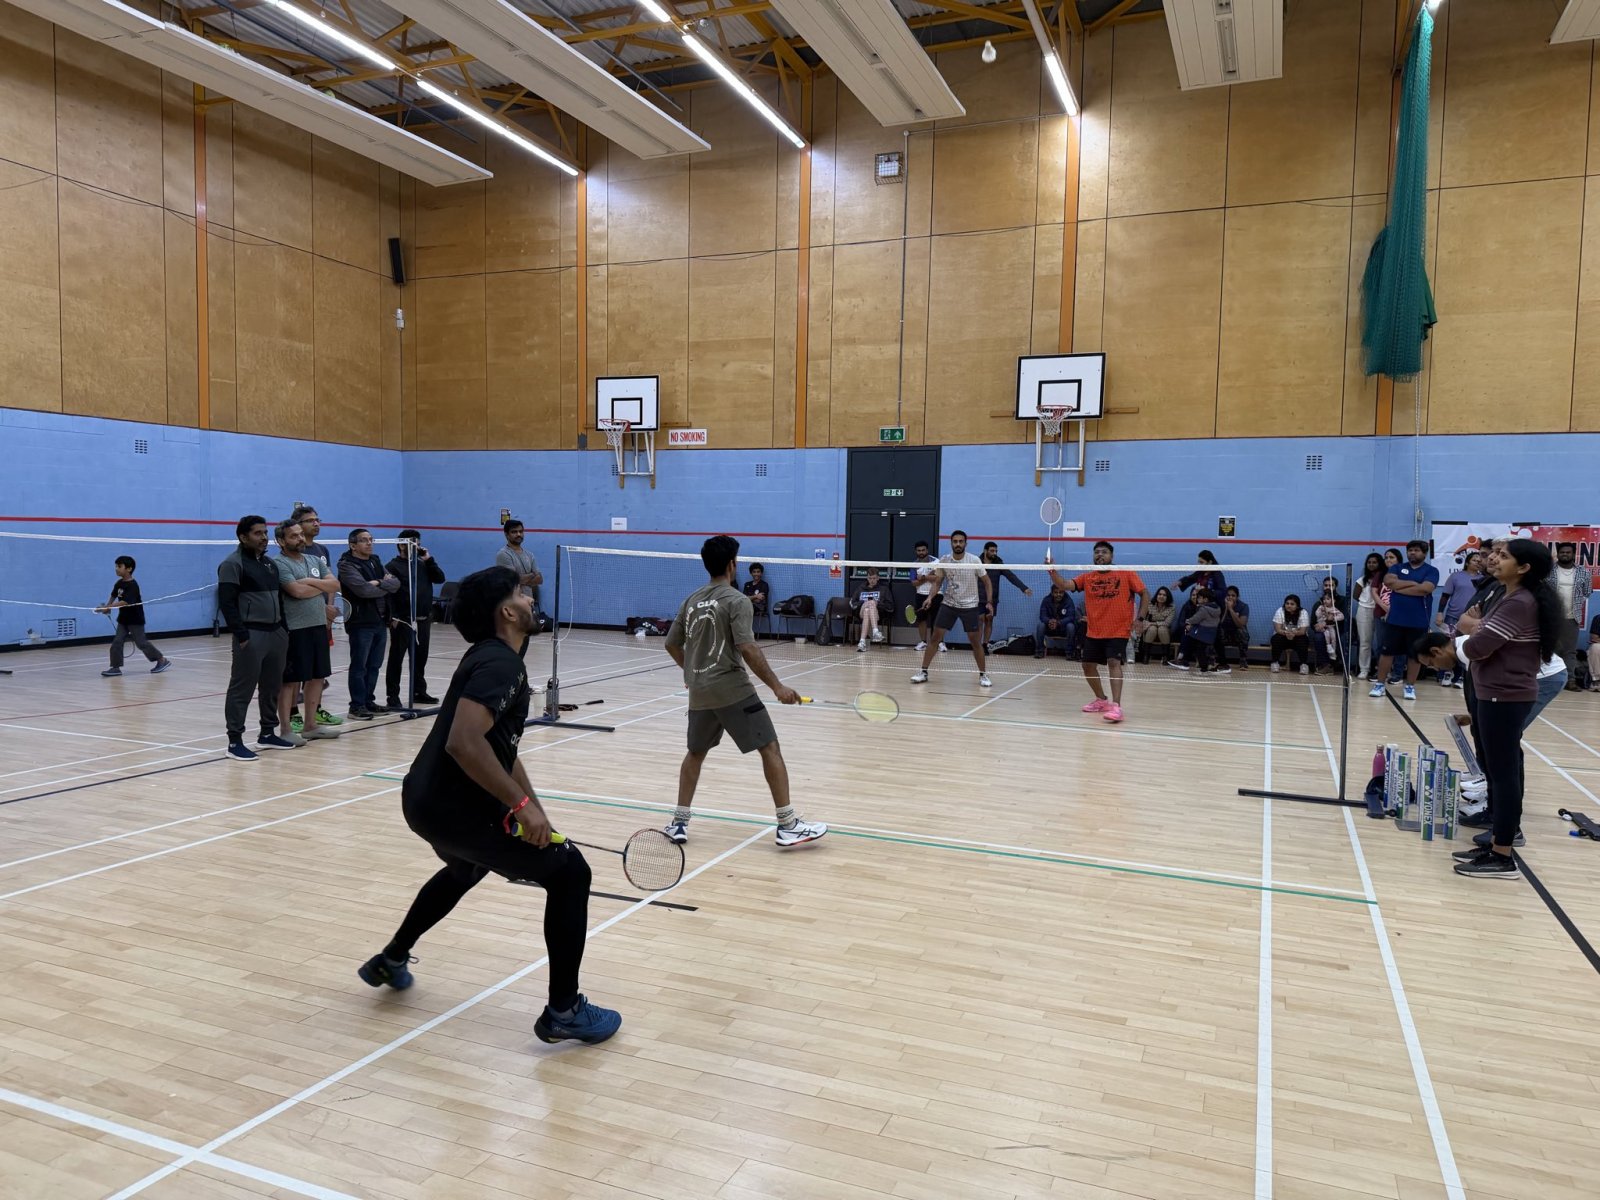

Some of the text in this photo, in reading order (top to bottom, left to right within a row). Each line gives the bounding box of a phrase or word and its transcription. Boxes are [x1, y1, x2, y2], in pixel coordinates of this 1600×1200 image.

[671, 432, 705, 442] NO SMOKING
[1397, 770, 1405, 792] YONEX
[1445, 788, 1454, 811] YONEX
[1424, 801, 1432, 825] YONEX
